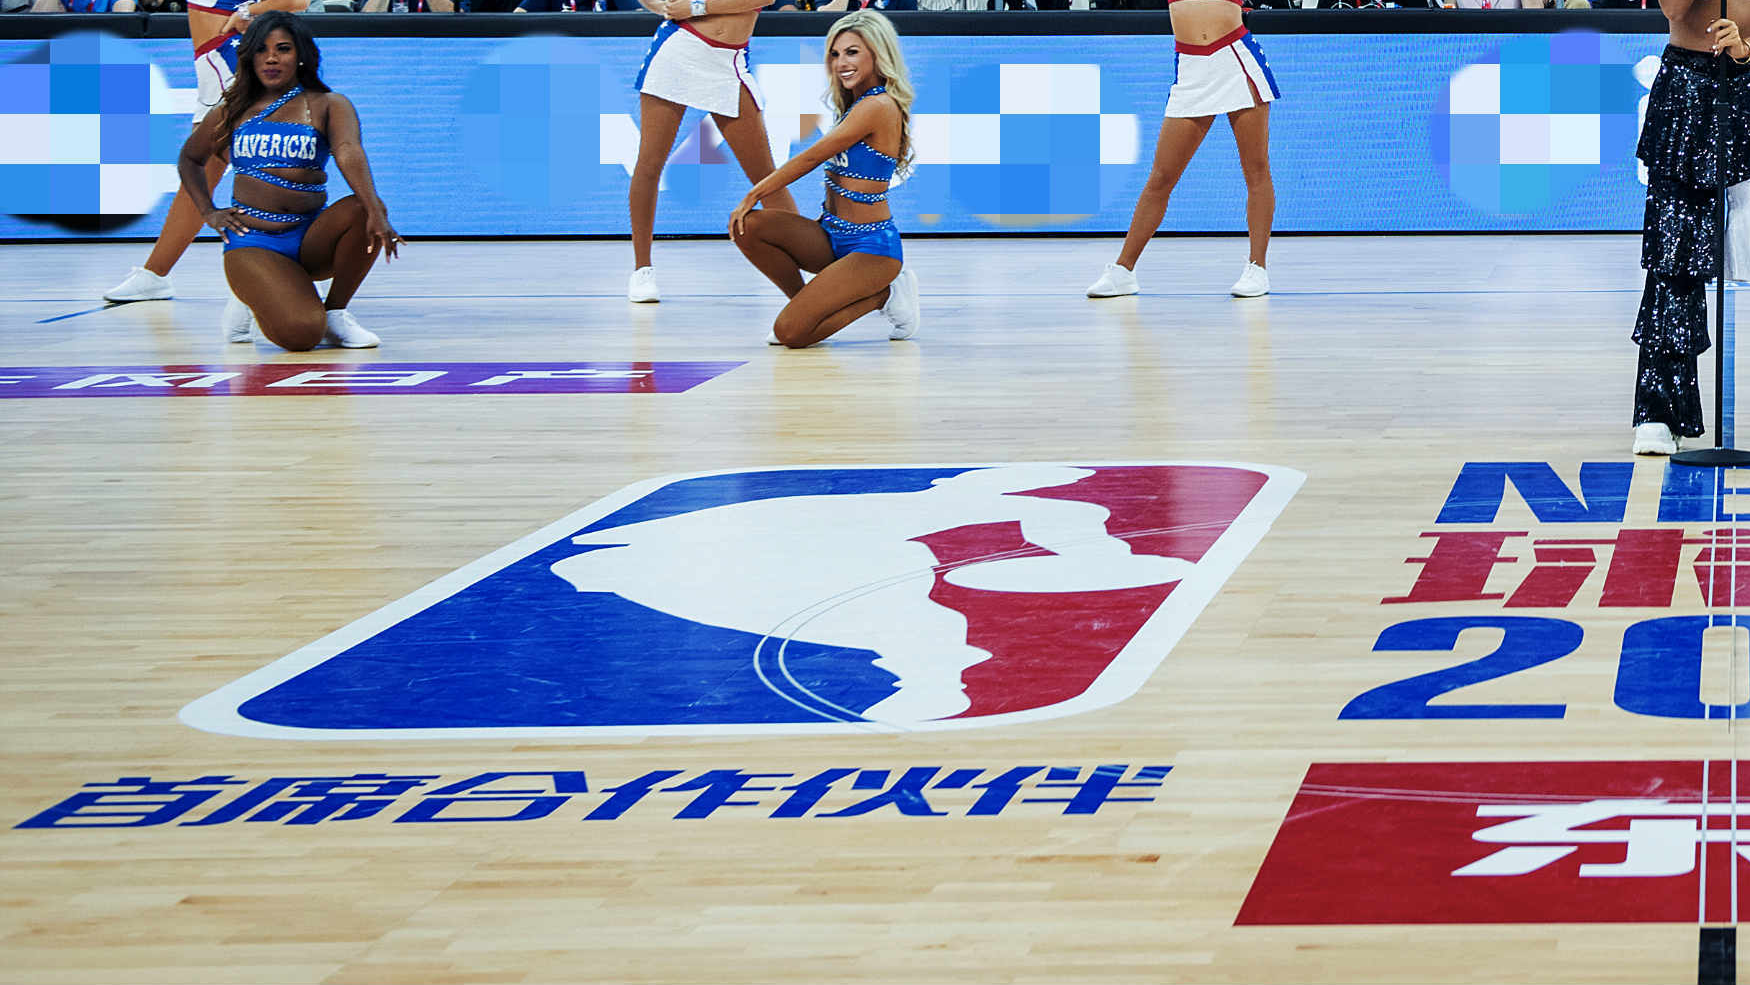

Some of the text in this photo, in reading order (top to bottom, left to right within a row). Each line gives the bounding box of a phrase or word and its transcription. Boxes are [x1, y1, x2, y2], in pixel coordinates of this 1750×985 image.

[233, 132, 317, 162] MAVERICKS
[13, 764, 1175, 829] 首席合作伙伴
